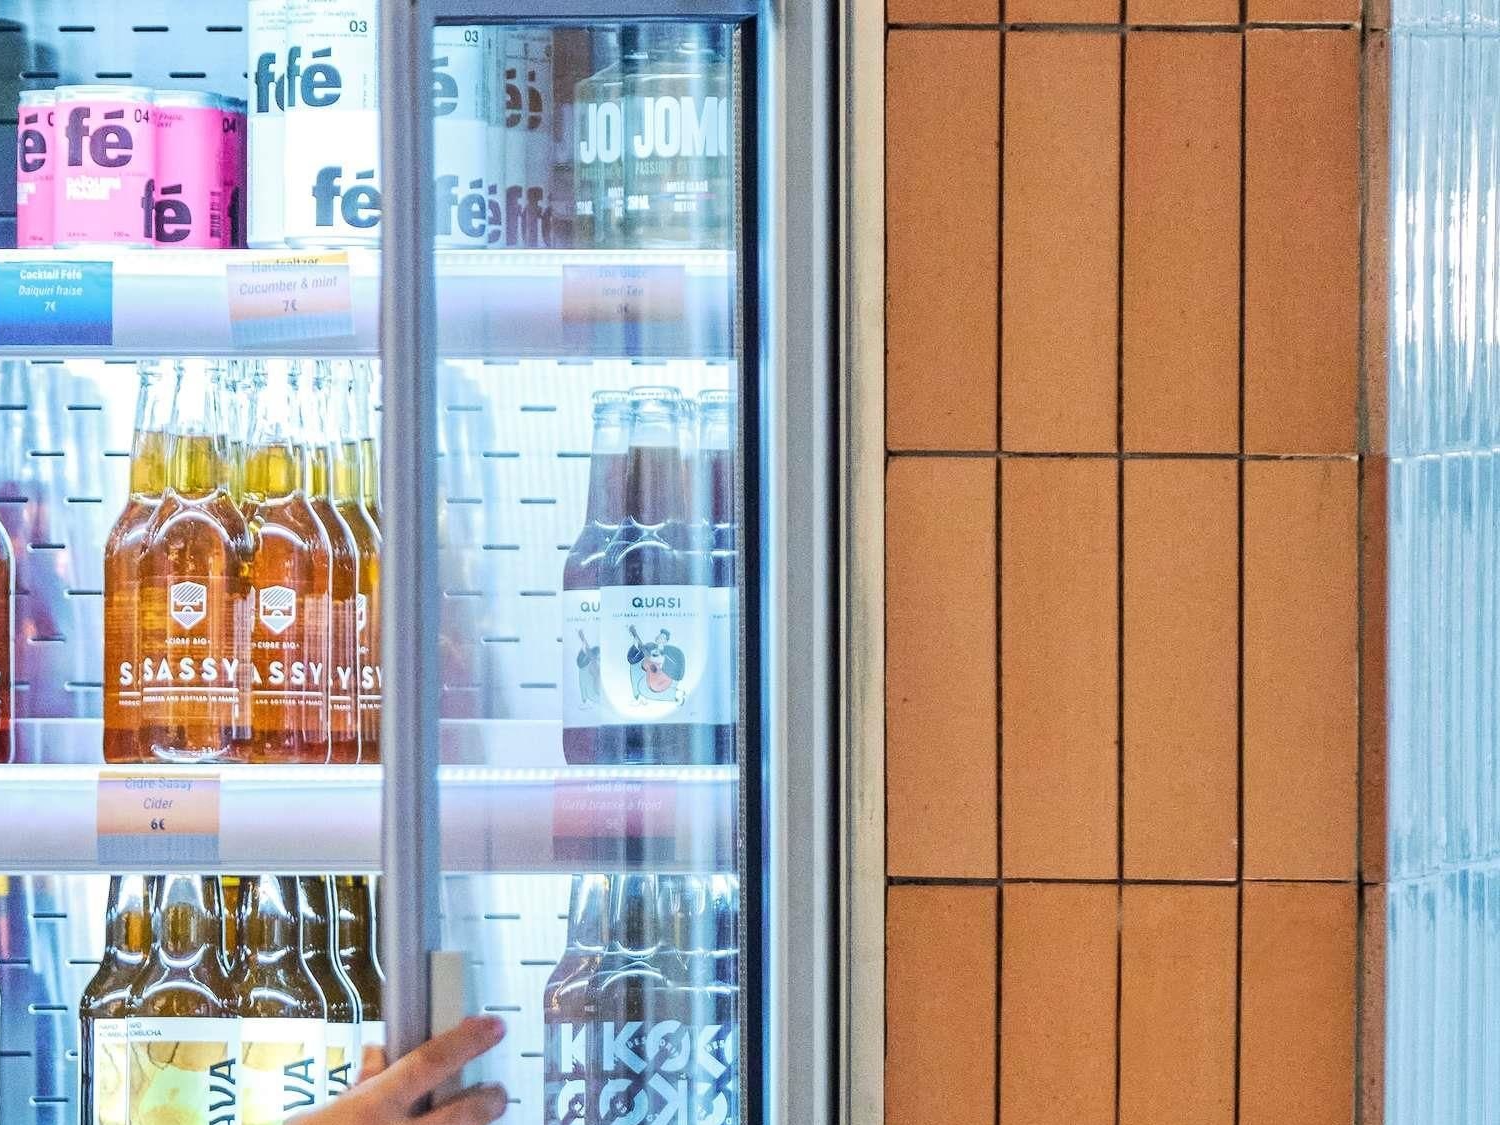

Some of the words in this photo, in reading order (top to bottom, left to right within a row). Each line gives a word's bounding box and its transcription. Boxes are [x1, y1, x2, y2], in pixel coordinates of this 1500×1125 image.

[350, 21, 367, 33] 03
[464, 30, 479, 42] 03
[287, 46, 342, 107] fé
[135, 110, 149, 123] 04
[222, 118, 236, 133] 04
[66, 107, 133, 168] fé
[312, 166, 381, 228] fé
[19, 268, 59, 280] Cocktail
[55, 284, 83, 296] fraise
[239, 281, 297, 296] Cucumber
[301, 277, 309, 289] &
[311, 276, 338, 288] mint
[44, 301, 56, 313] 7€
[283, 300, 298, 313] 7€
[632, 596, 682, 609] QUASI
[143, 657, 239, 681] SASSY
[143, 797, 174, 809] Cider
[150, 818, 165, 830] 6€
